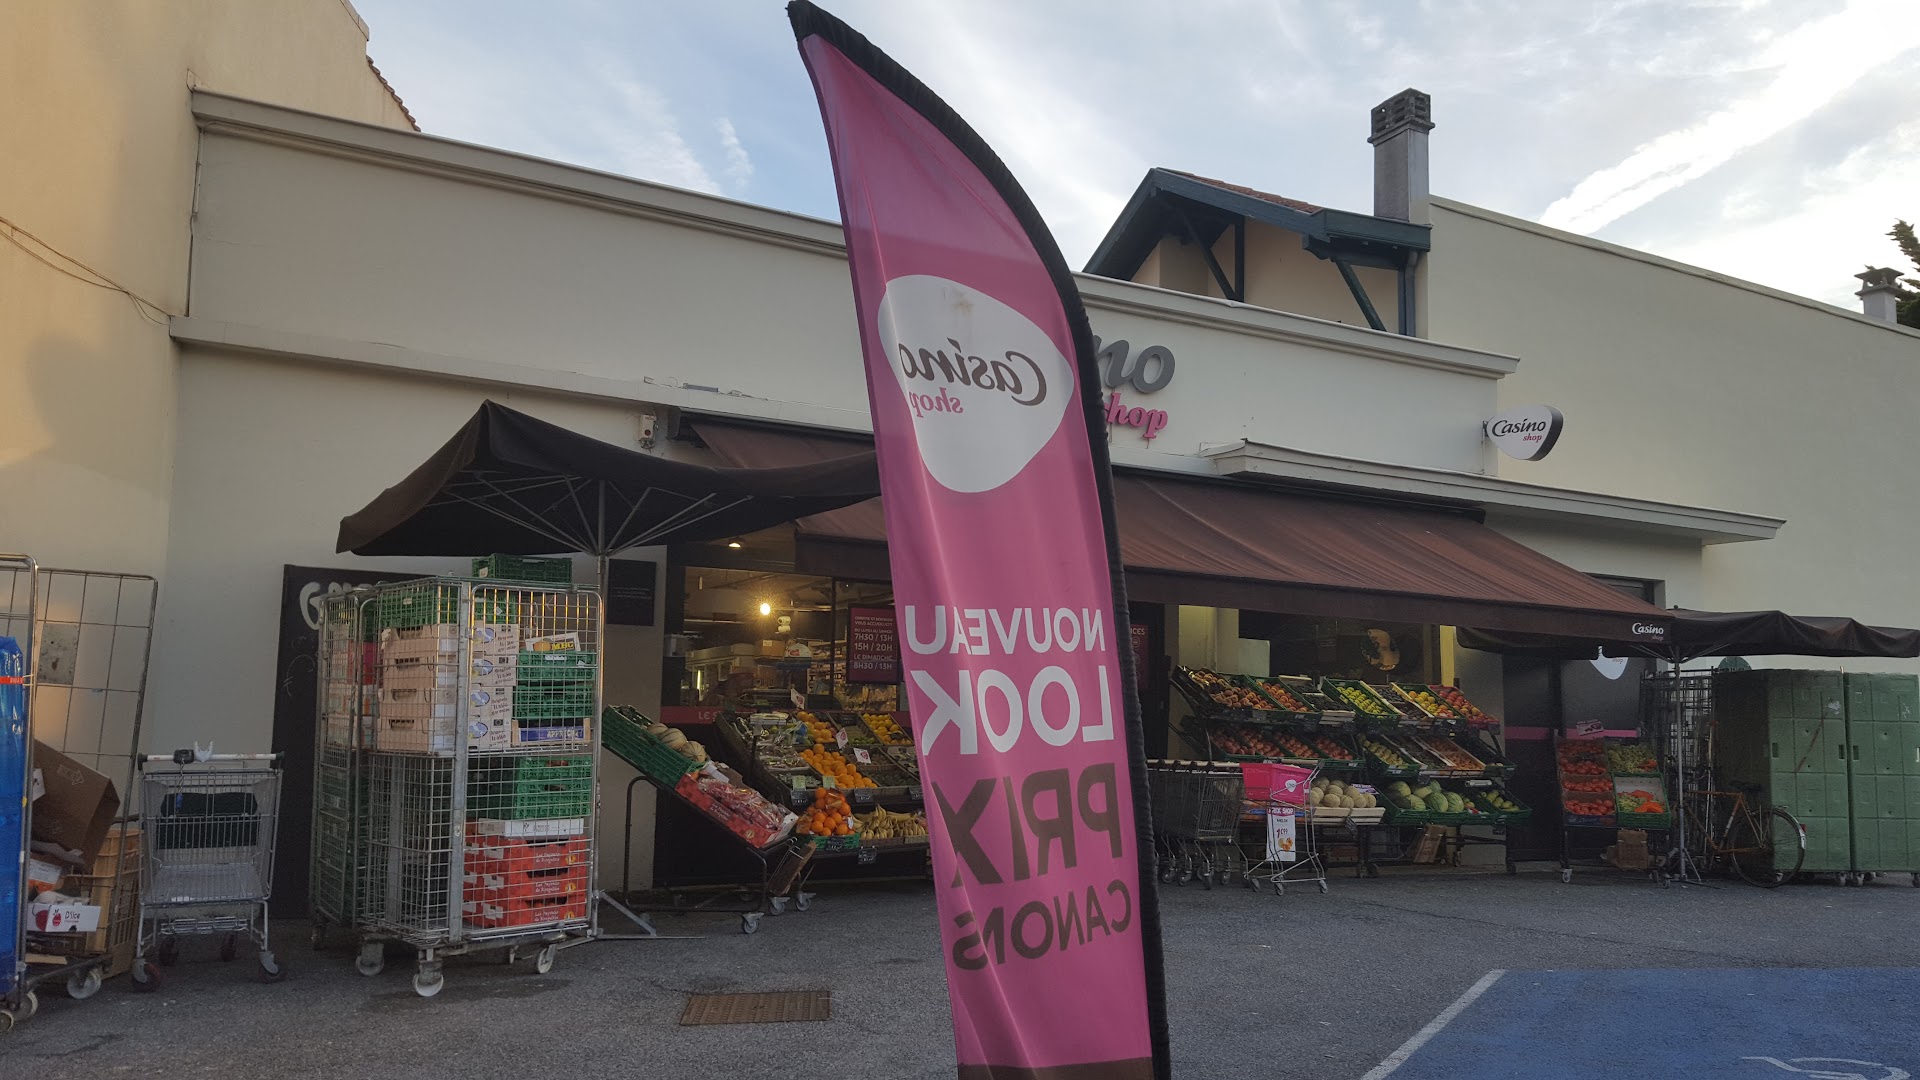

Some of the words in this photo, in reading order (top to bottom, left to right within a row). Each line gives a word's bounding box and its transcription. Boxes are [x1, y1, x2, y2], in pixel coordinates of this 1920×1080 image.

[1104, 392, 1168, 439] hop
[1491, 418, 1547, 437] Casino
[1522, 433, 1543, 443] shop
[1631, 622, 1664, 635] Casino
[854, 633, 874, 641] 7H30
[879, 634, 893, 642] 13H
[854, 642, 869, 651] 15H
[876, 643, 893, 652] 20H
[854, 662, 874, 670] 8H30
